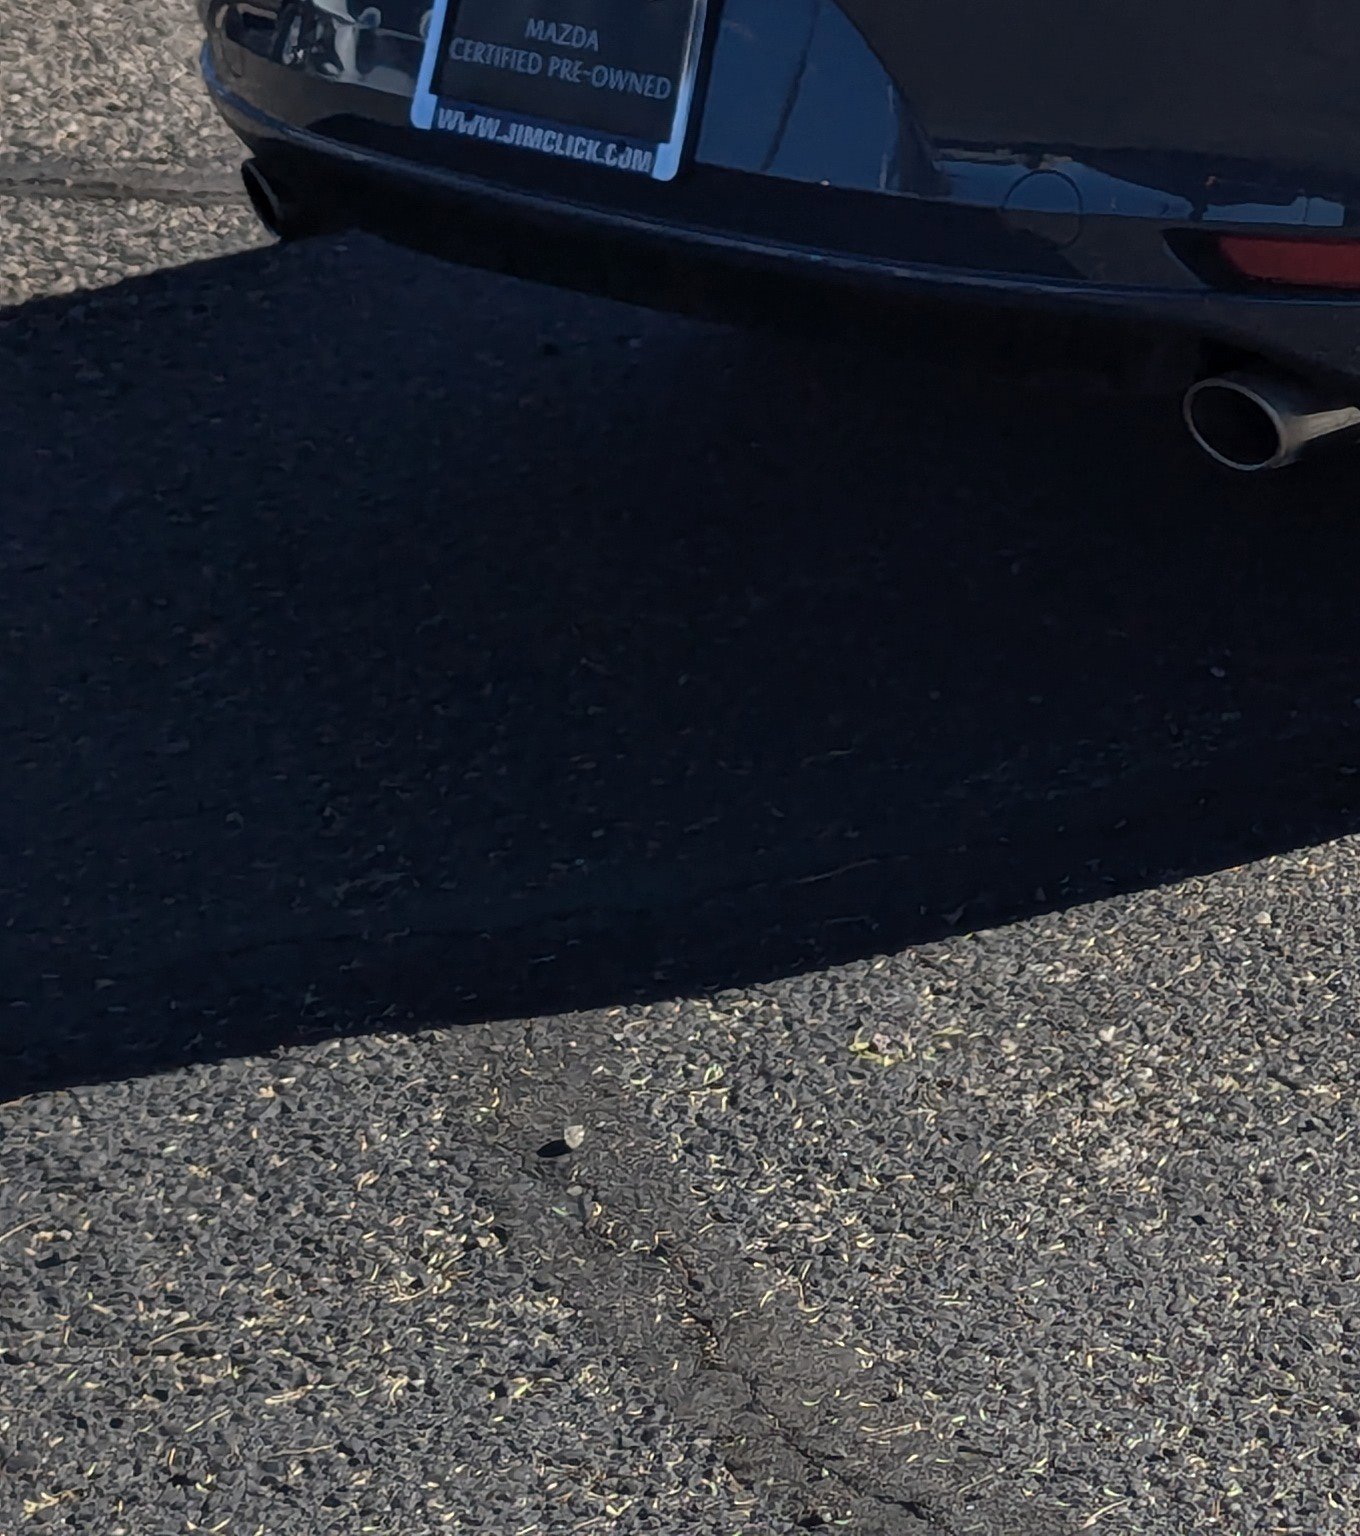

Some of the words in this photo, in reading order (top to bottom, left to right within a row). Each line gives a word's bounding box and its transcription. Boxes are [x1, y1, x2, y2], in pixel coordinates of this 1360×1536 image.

[524, 16, 600, 53] MAZDA
[447, 36, 544, 76] CERTIFIED
[547, 54, 673, 100] PRE-OWNED
[437, 106, 654, 173] WWW.JIMCLICK.COM
